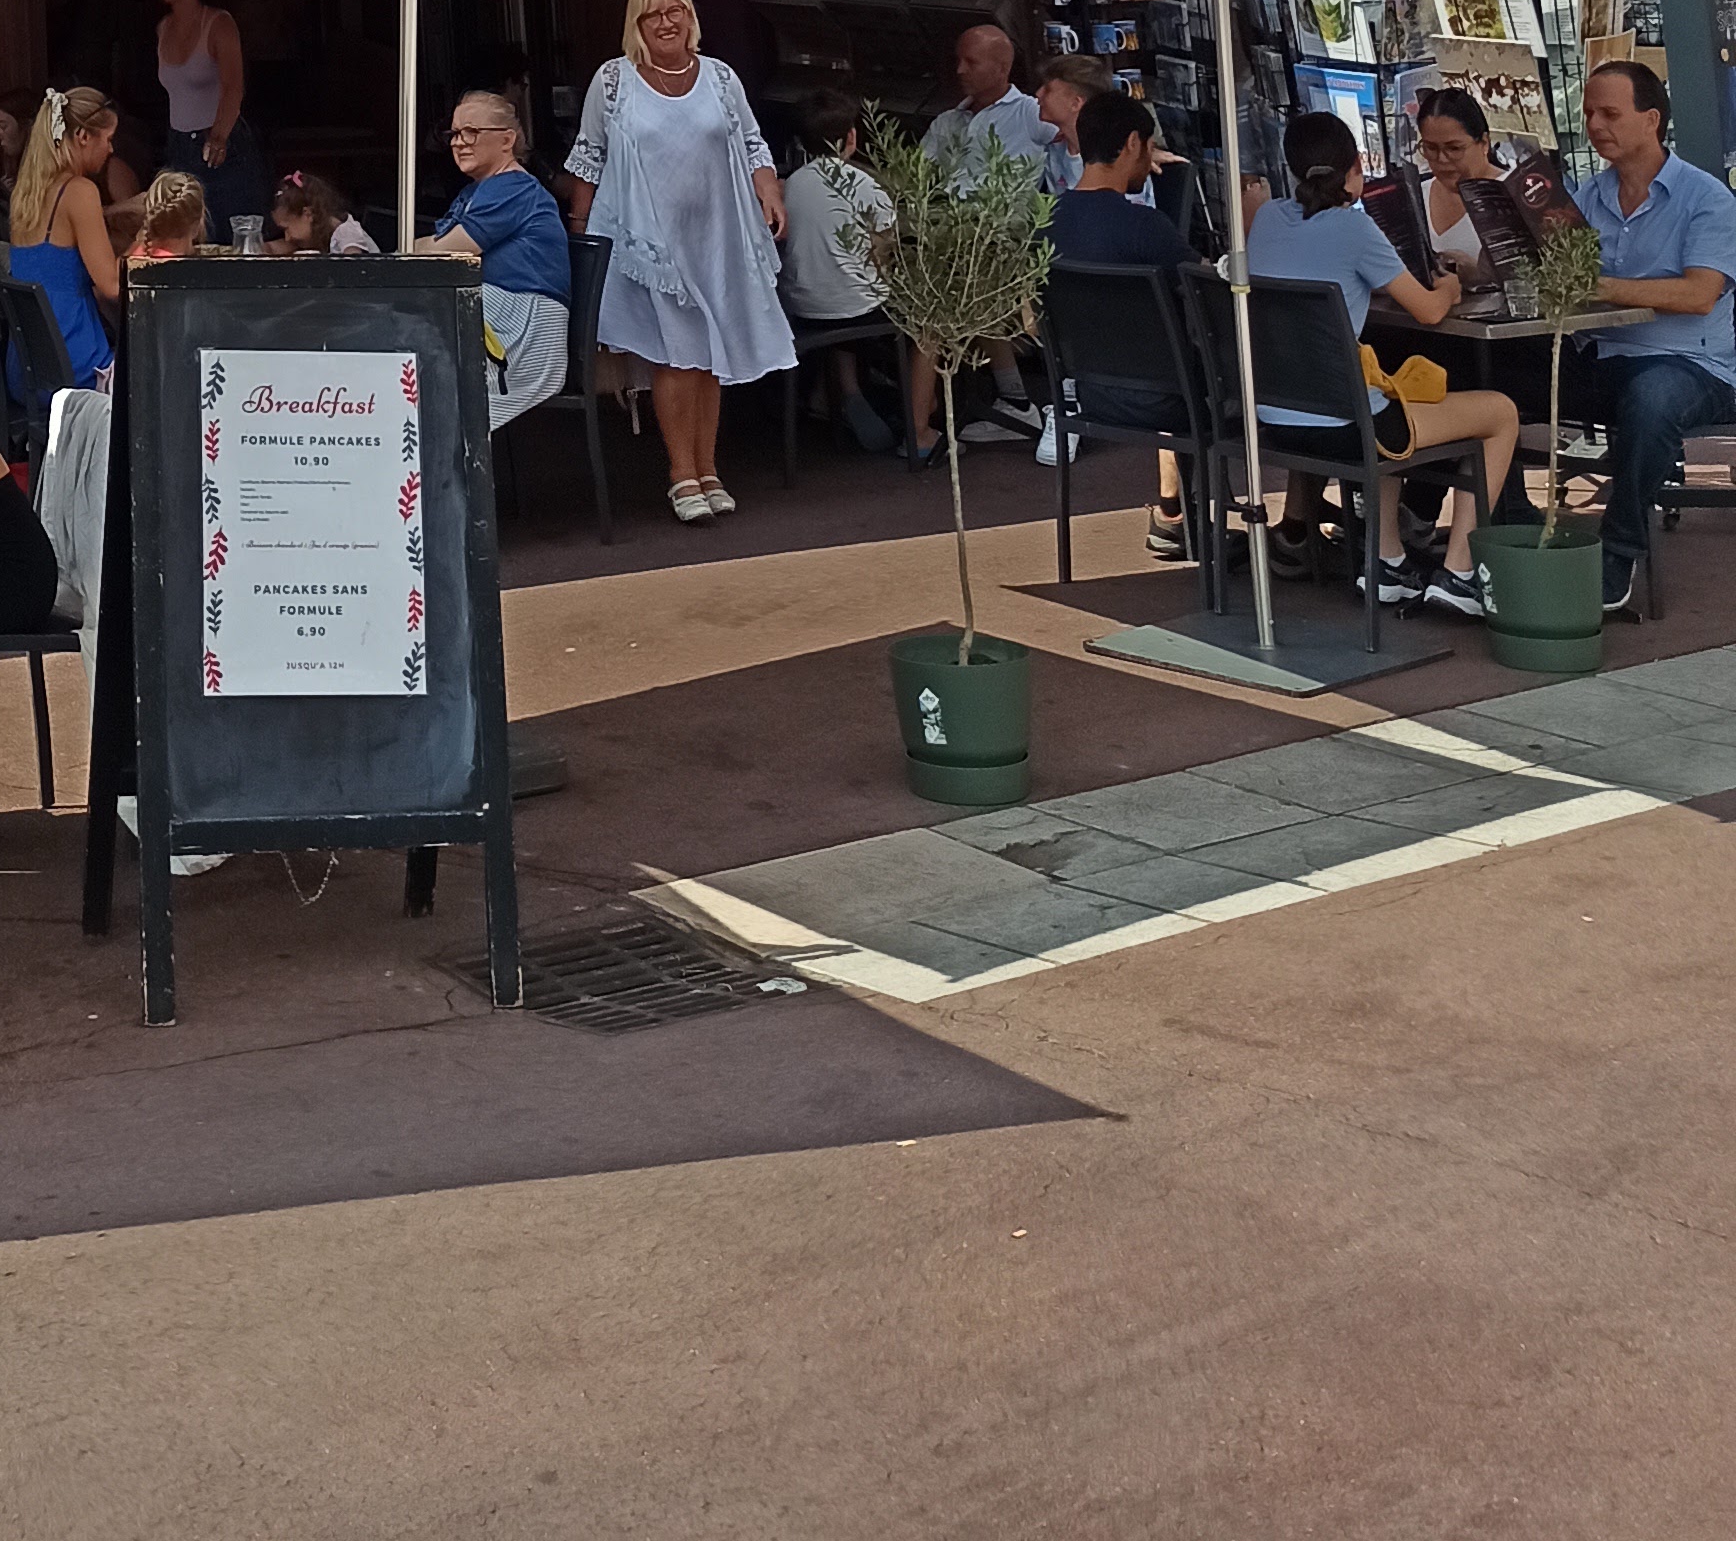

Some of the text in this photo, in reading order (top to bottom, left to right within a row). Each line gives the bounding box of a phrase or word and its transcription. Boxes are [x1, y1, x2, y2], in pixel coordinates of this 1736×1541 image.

[241, 384, 376, 419] Breakfast
[240, 435, 381, 447] FORMULE PANCAKES
[293, 456, 329, 467] 10.90
[253, 584, 368, 595] PANCAKES SANS
[279, 605, 343, 616] FORMULE
[296, 626, 326, 637] 6.90
[328, 661, 345, 670] 12H
